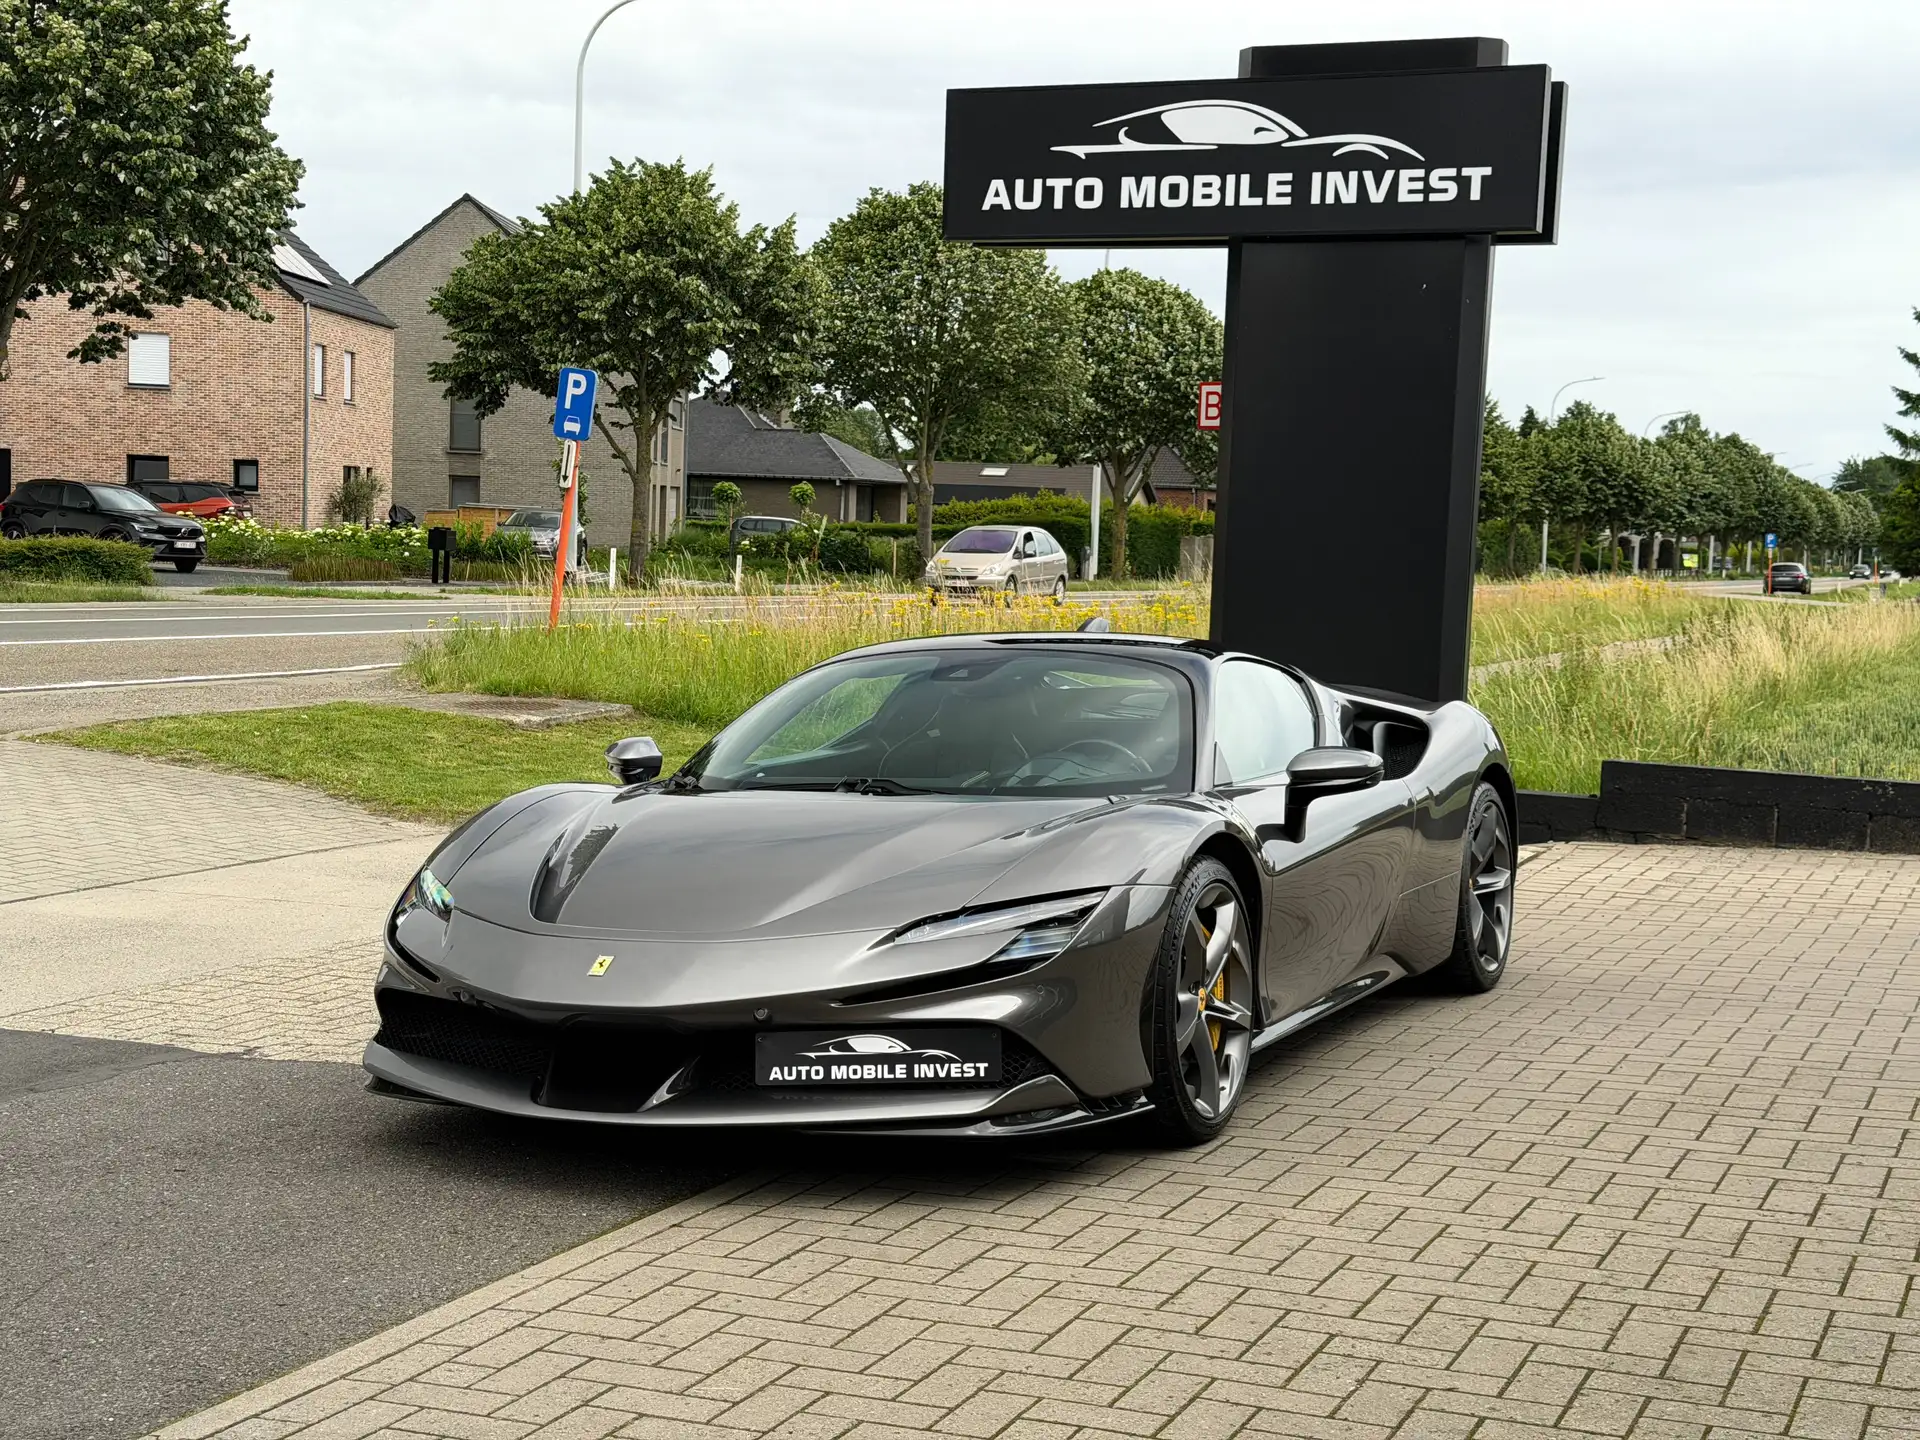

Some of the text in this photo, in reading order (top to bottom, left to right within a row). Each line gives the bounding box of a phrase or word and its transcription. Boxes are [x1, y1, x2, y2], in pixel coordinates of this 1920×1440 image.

[981, 166, 1493, 211] AUTO MOBILE INVEST
[564, 372, 587, 409] P
[1205, 391, 1222, 420] B
[768, 1062, 989, 1081] AUTO MOBILE INVEST
